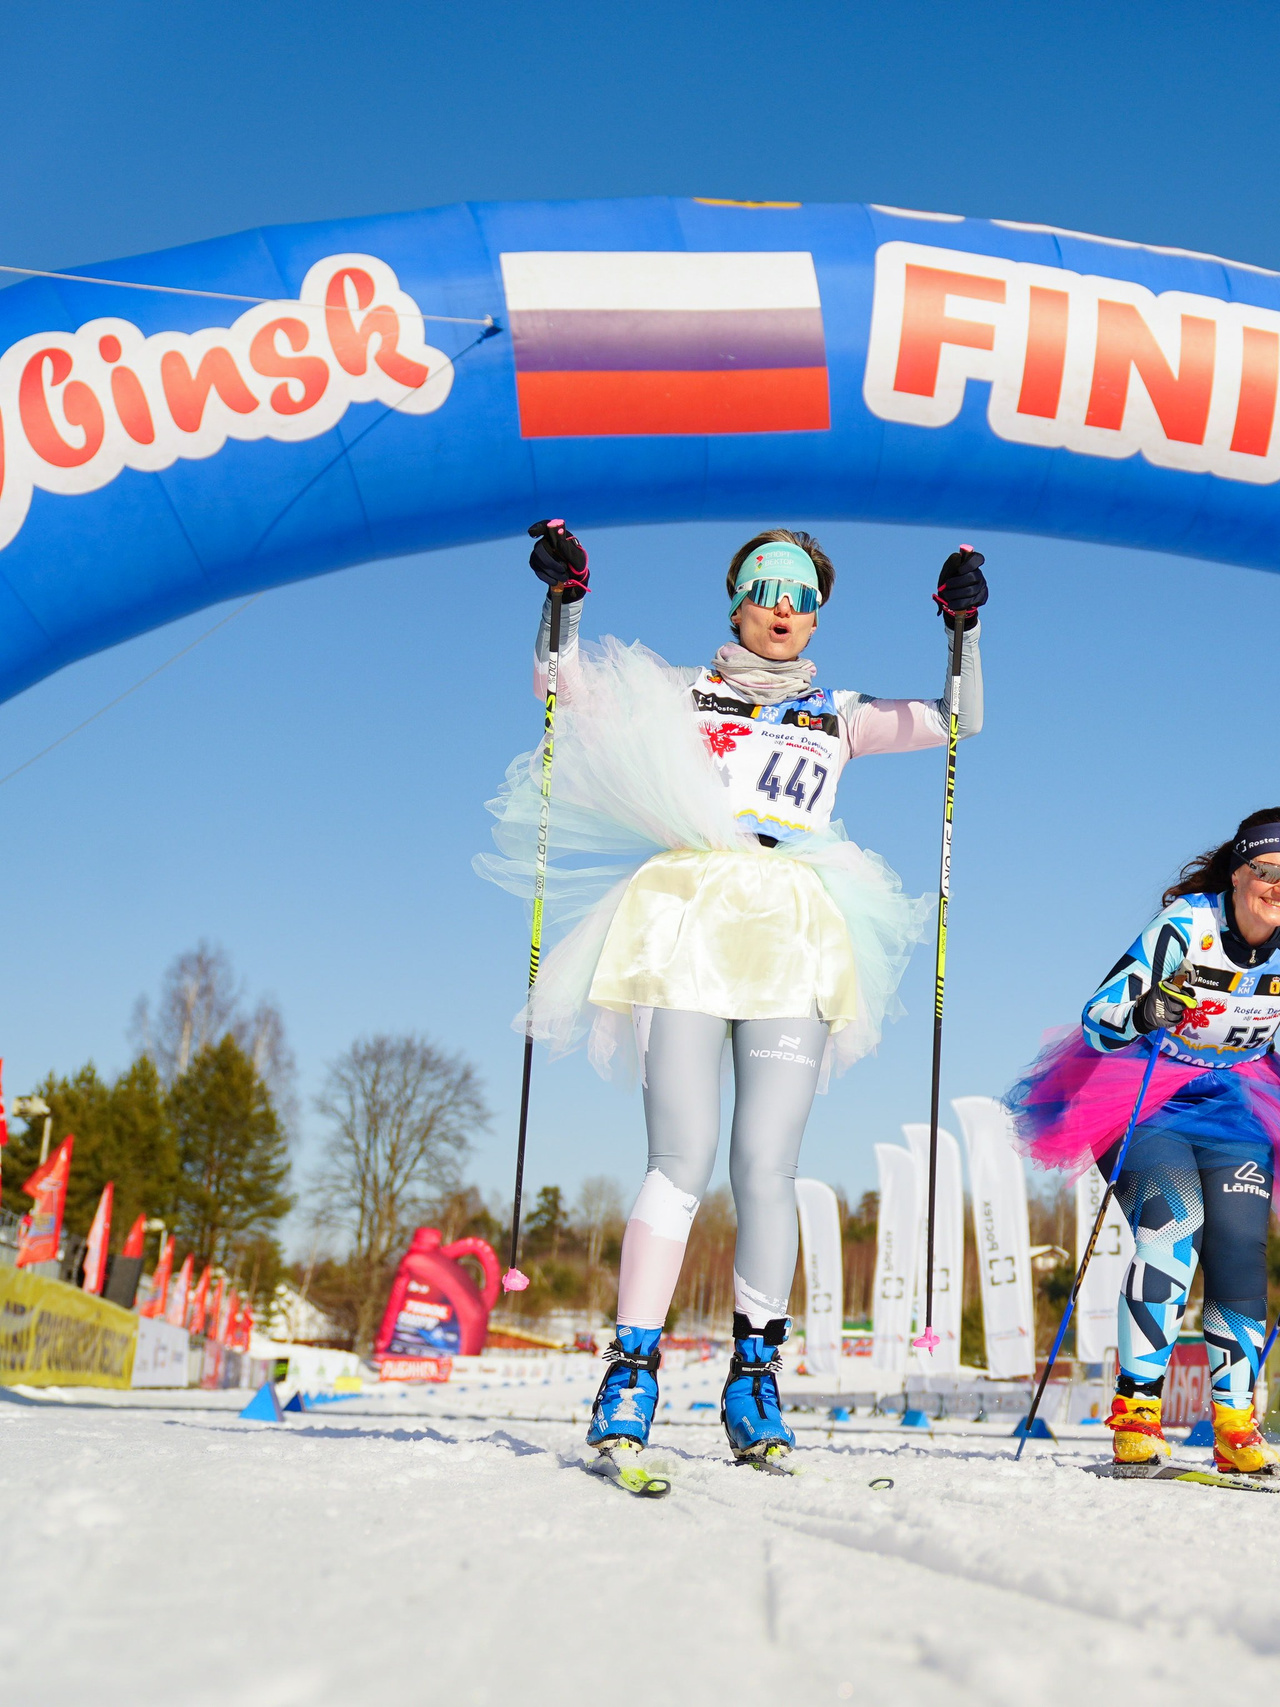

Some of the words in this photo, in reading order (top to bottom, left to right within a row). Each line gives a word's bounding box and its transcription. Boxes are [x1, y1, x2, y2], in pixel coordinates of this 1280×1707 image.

[761, 713, 776, 723] KM
[761, 730, 795, 741] Rostec
[785, 742, 822, 757] marathon
[756, 750, 829, 813] 447
[1248, 836, 1280, 849] Rostec
[1197, 976, 1220, 987] Rostec
[1241, 976, 1256, 987] 25
[1237, 985, 1251, 995] KM
[1233, 1006, 1262, 1015] Rostec
[749, 1049, 817, 1068] NORDSKI
[1112, 1466, 1151, 1478] FISCHER
